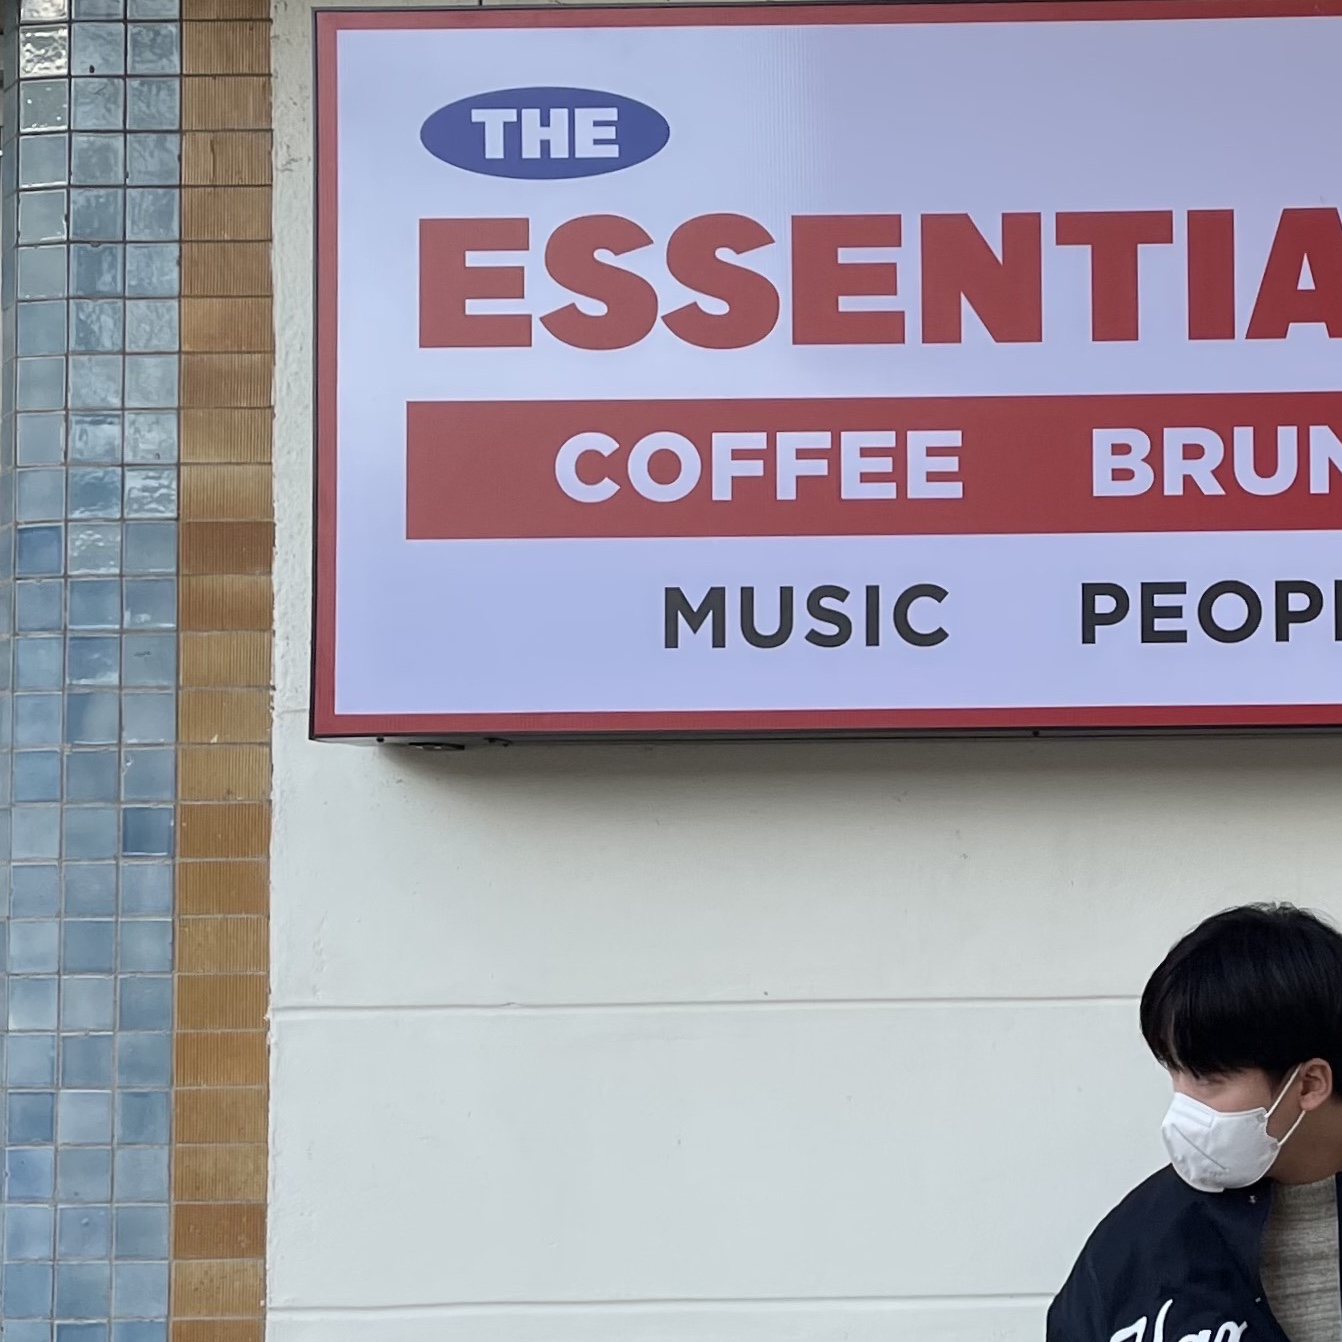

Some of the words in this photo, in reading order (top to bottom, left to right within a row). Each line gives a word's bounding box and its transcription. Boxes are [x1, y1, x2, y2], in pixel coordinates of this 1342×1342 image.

[471, 107, 620, 159] THE
[554, 429, 964, 503] COFFEE
[663, 583, 950, 650] MUSIC
